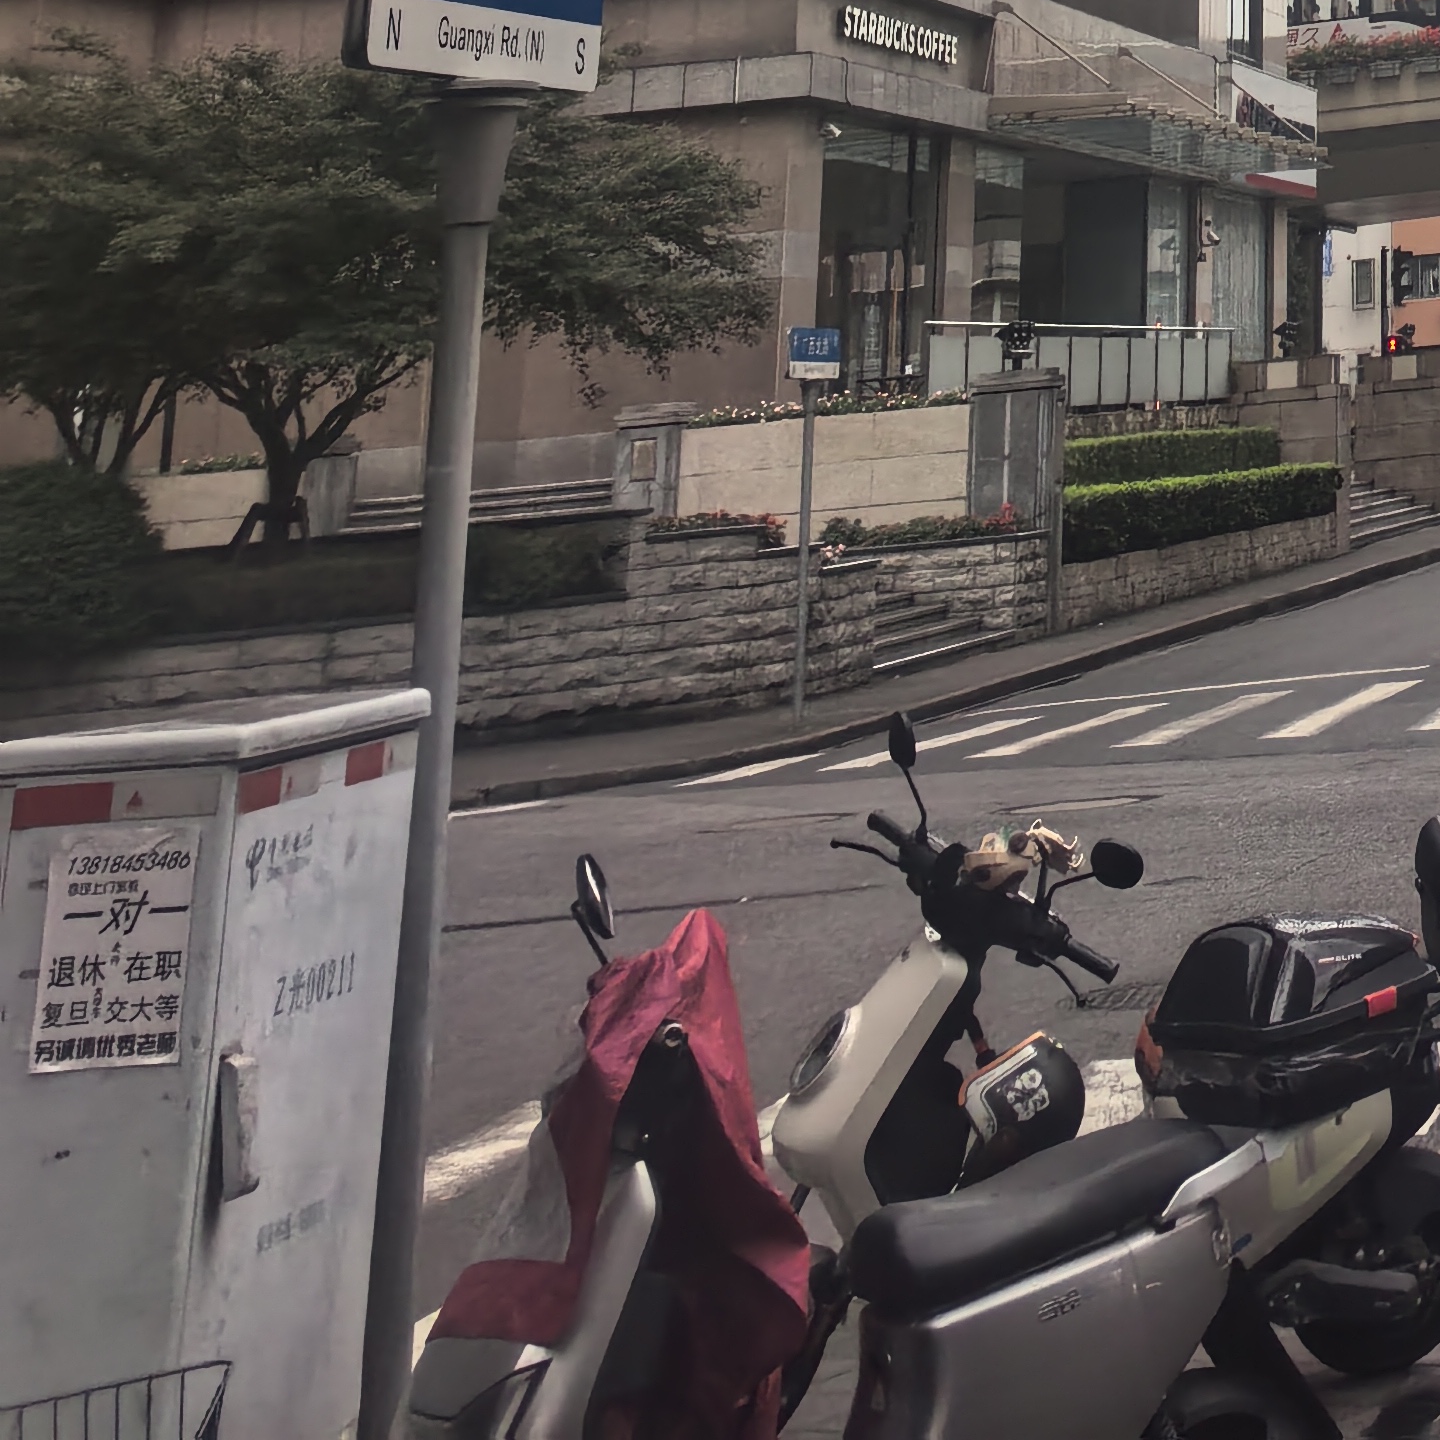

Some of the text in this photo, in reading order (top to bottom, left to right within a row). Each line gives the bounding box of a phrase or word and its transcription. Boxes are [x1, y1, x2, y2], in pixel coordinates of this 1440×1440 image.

[386, 7, 402, 51] N
[438, 16, 496, 61] Guangxi
[575, 38, 586, 75] S
[843, 4, 959, 65] STARBUCKS COFFEE
[63, 890, 189, 936] 一对一
[47, 953, 107, 989] 退休
[123, 950, 183, 983] 在职
[40, 1000, 90, 1029] 复旦
[104, 993, 179, 1025] 交大等
